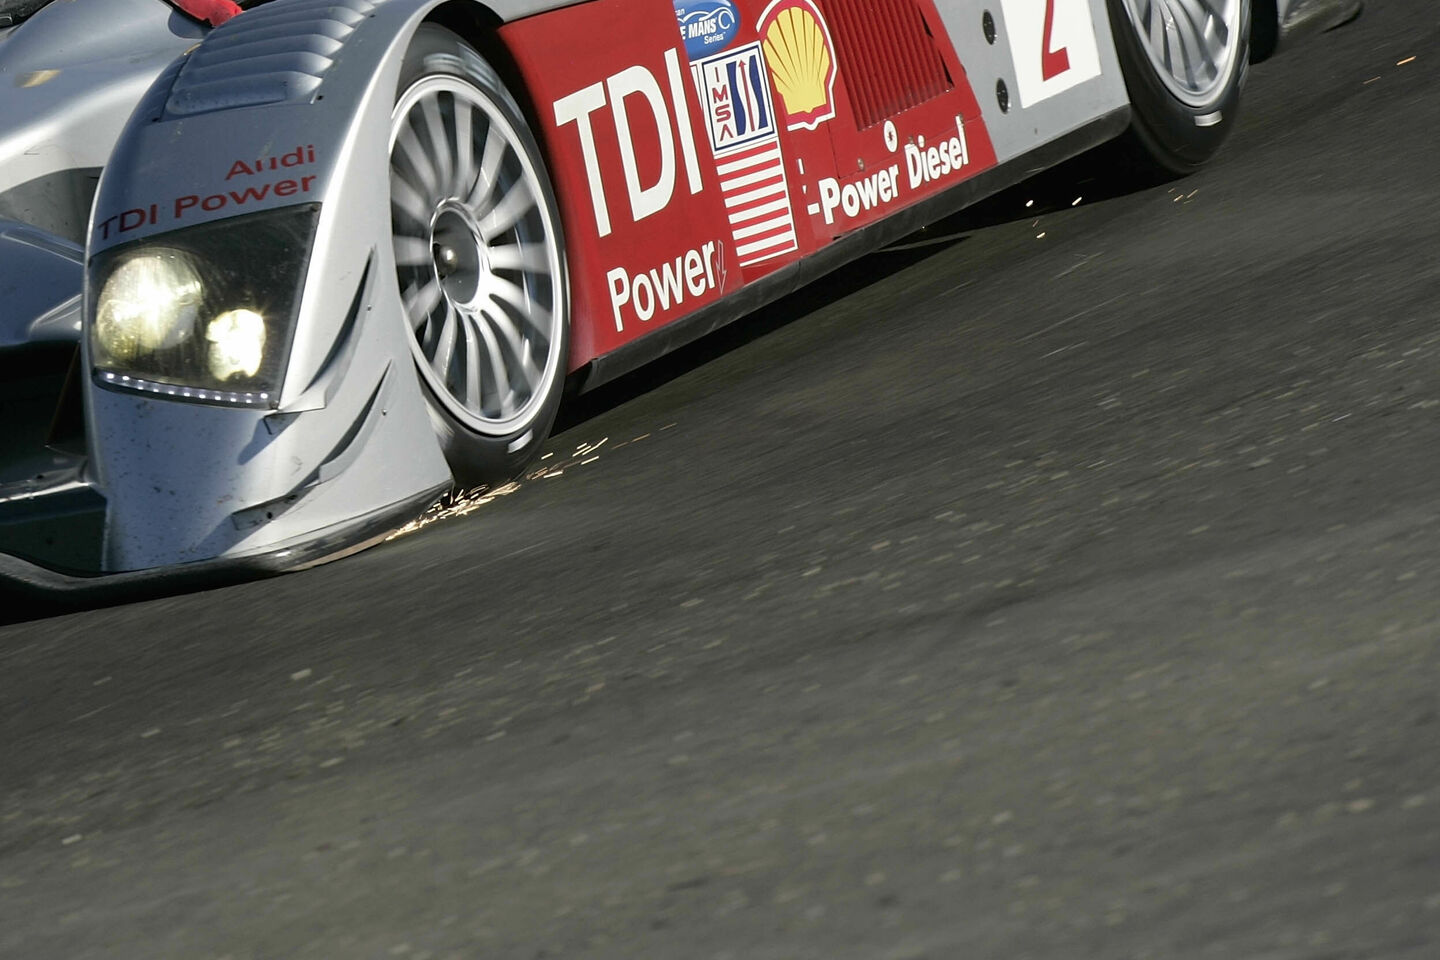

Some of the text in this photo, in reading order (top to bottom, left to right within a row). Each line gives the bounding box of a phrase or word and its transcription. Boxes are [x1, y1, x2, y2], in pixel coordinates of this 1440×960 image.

[688, 18, 718, 39] MANS
[704, 32, 724, 45] Series
[711, 66, 734, 142] IMSA
[224, 144, 316, 180] Audi
[553, 46, 704, 238] TDI
[904, 114, 969, 190] Diesel
[97, 175, 317, 242] TDI Power
[606, 239, 716, 334] Power
